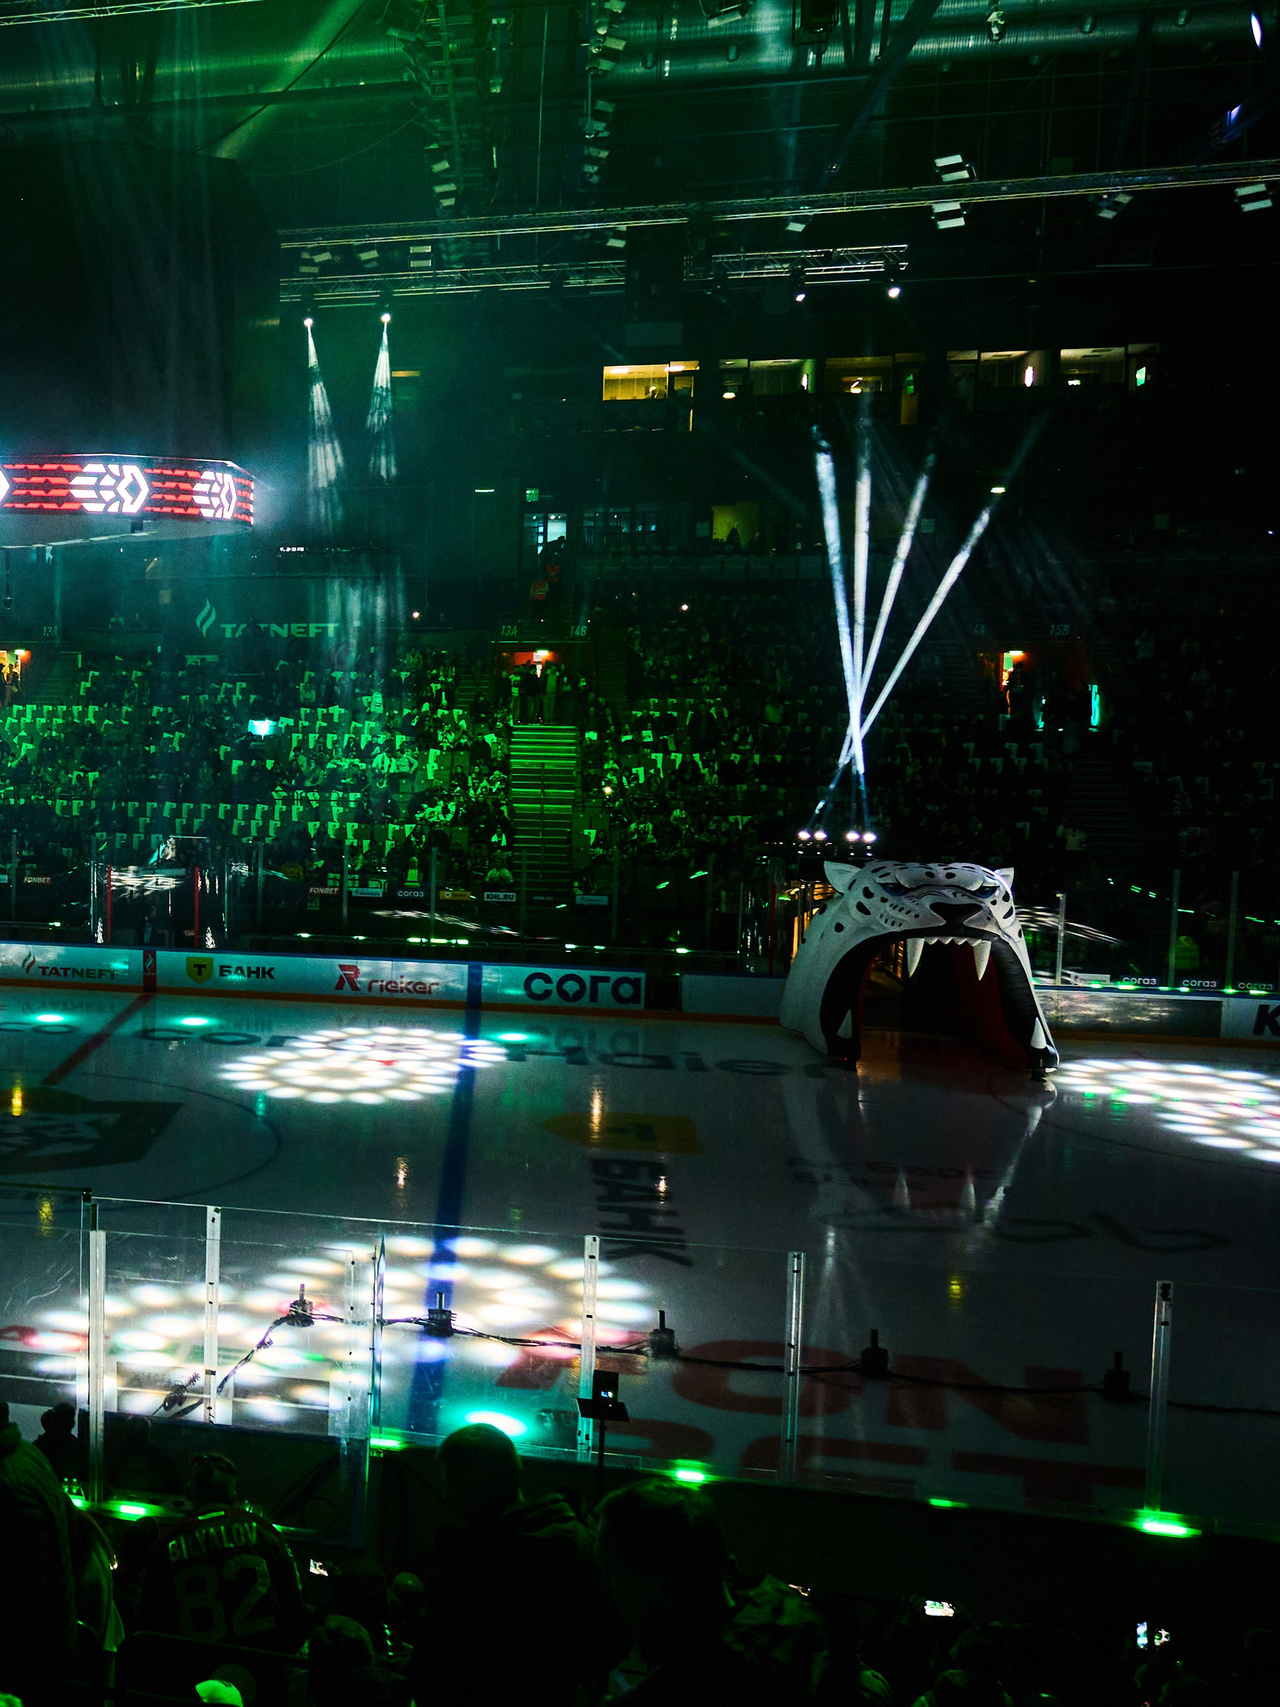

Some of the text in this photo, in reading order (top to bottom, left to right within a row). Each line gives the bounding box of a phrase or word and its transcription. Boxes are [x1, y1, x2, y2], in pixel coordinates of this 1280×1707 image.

[23, 876, 51, 884] FONBET
[309, 887, 339, 895] FONBET
[486, 893, 515, 901] KHL.RU
[38, 965, 118, 980] TATNEFT
[219, 964, 276, 980] БАНК
[368, 975, 440, 995] rieker
[1122, 976, 1158, 986] согаз
[1182, 978, 1217, 988] согаз
[588, 1158, 694, 1268] БАНК
[168, 1521, 258, 1563] BILYALOV
[174, 1553, 277, 1641] 82
